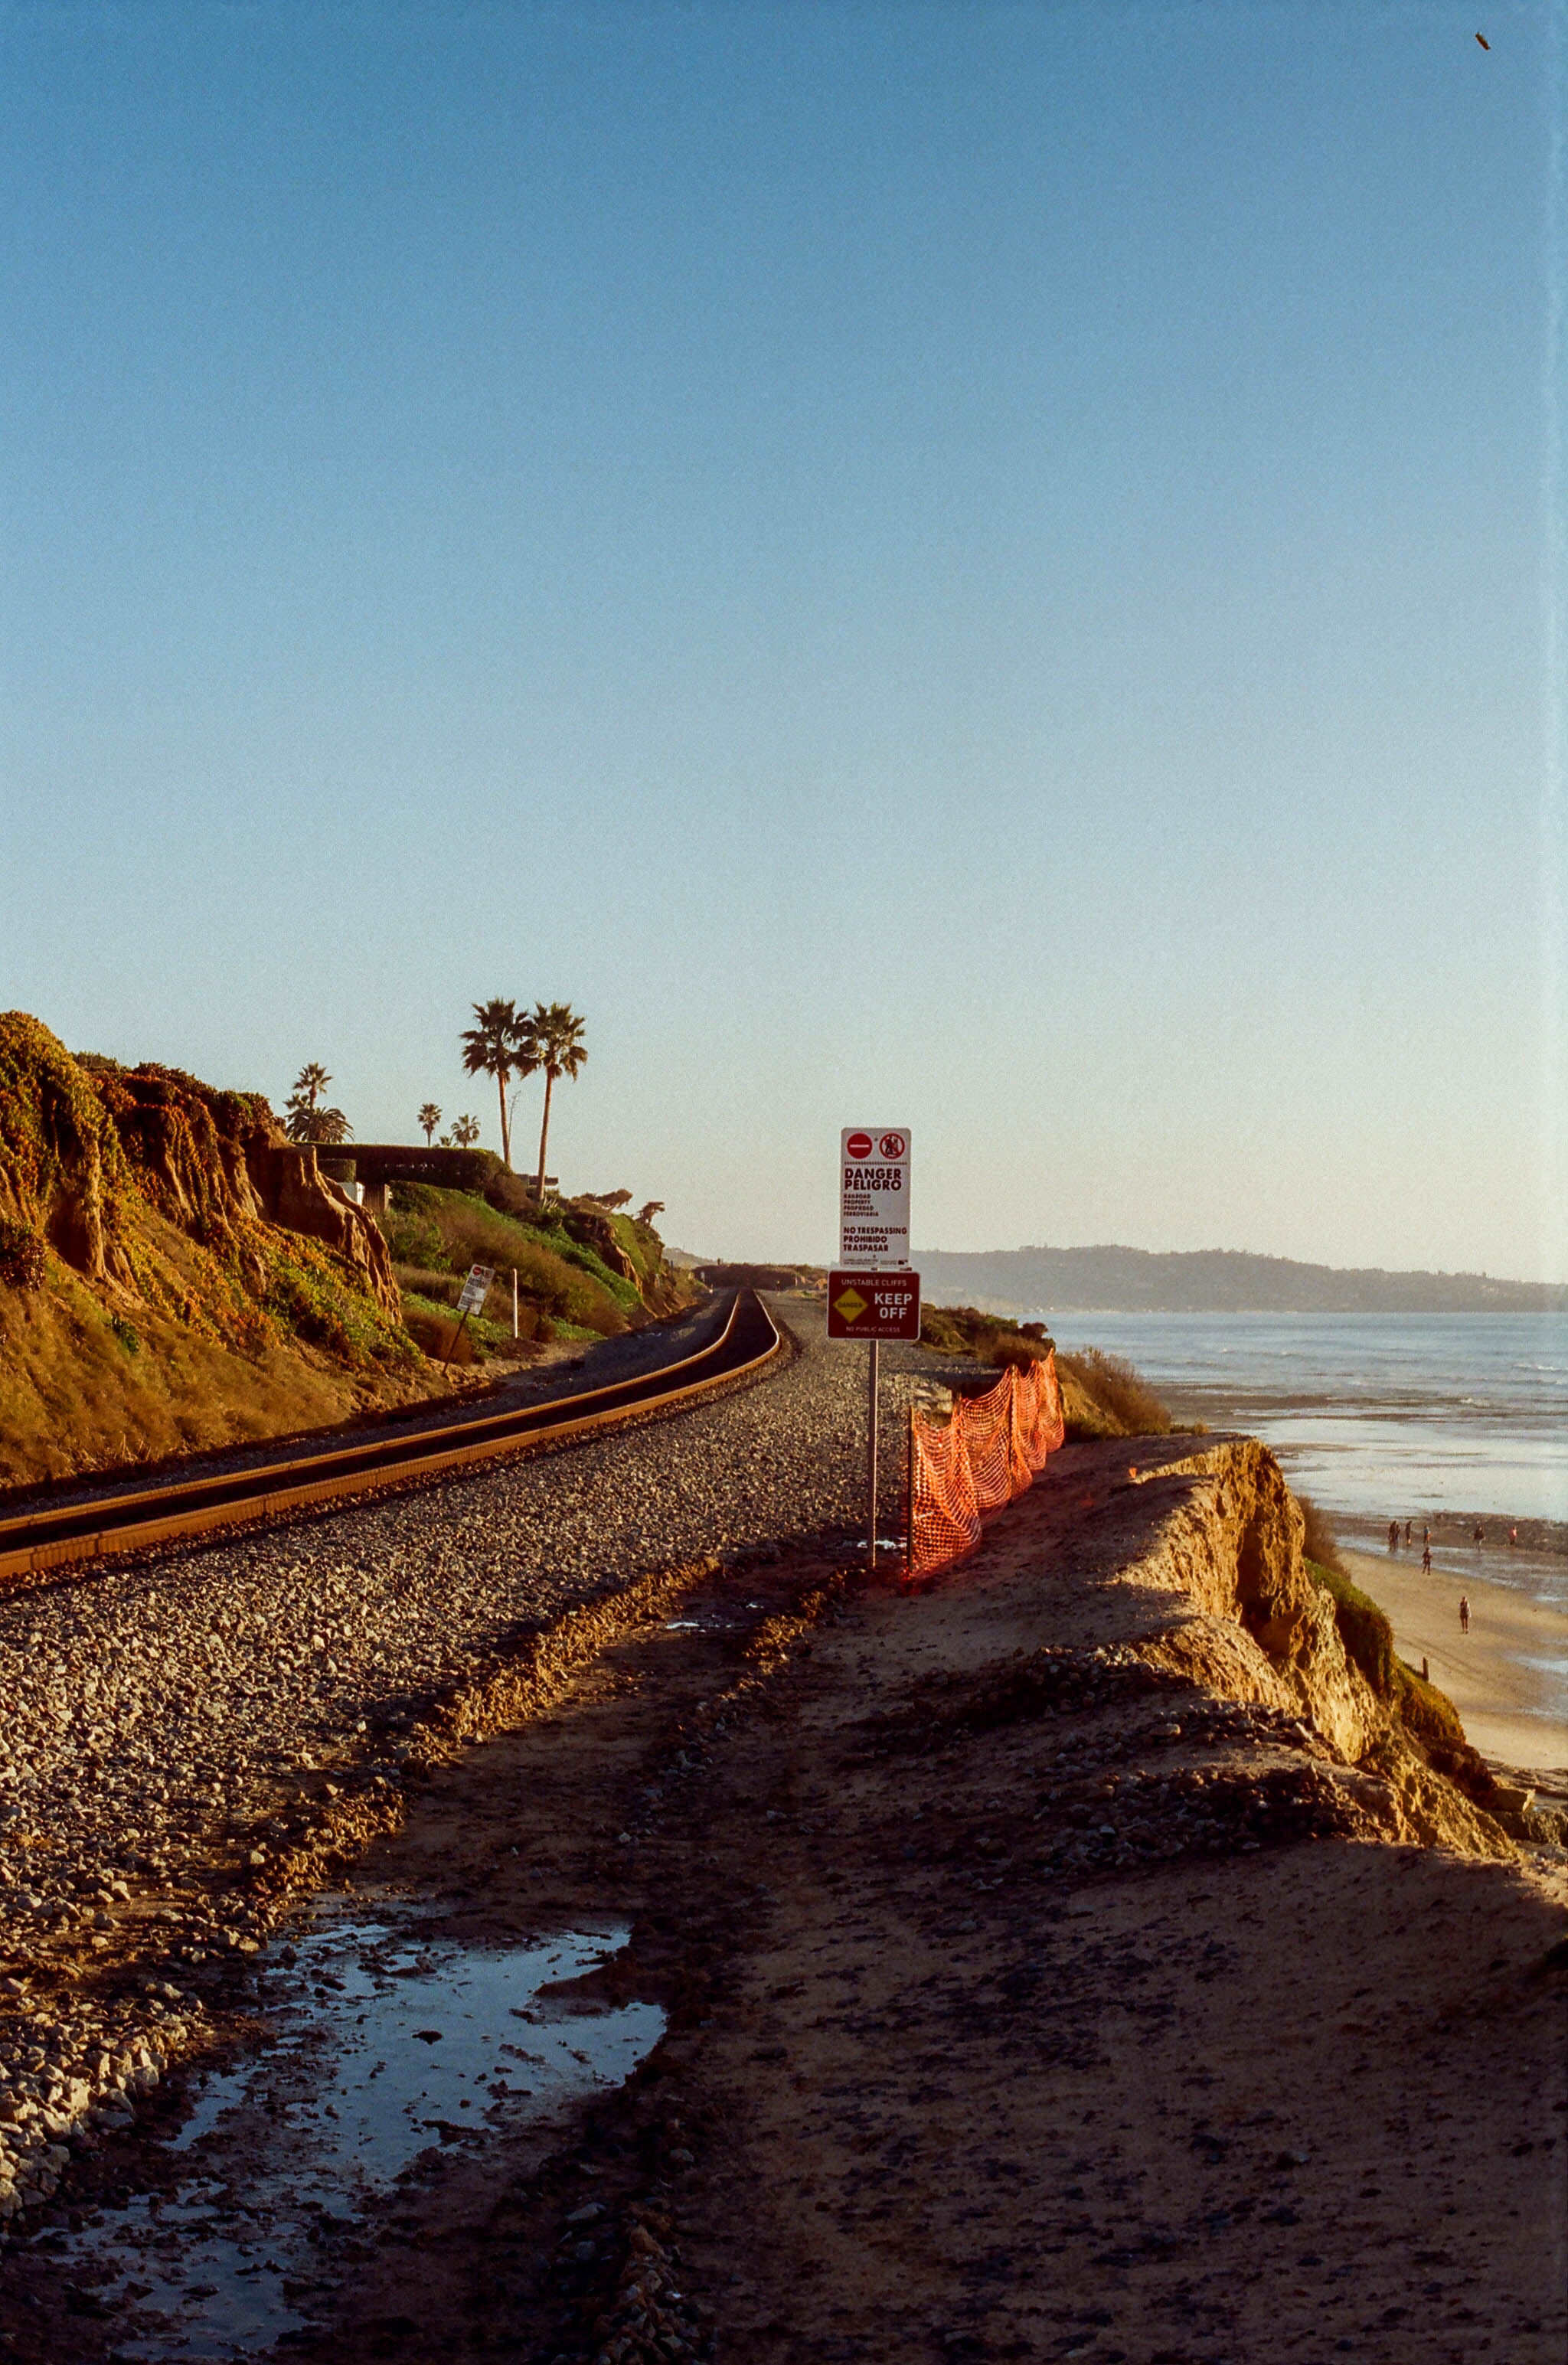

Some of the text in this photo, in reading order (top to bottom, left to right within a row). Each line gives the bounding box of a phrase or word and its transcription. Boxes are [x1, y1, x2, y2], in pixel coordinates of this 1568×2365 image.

[844, 1168, 902, 1179] DANGER
[844, 1180, 902, 1191] PELIGRO
[874, 1292, 913, 1305] KEEP
[880, 1307, 907, 1319] OFF
